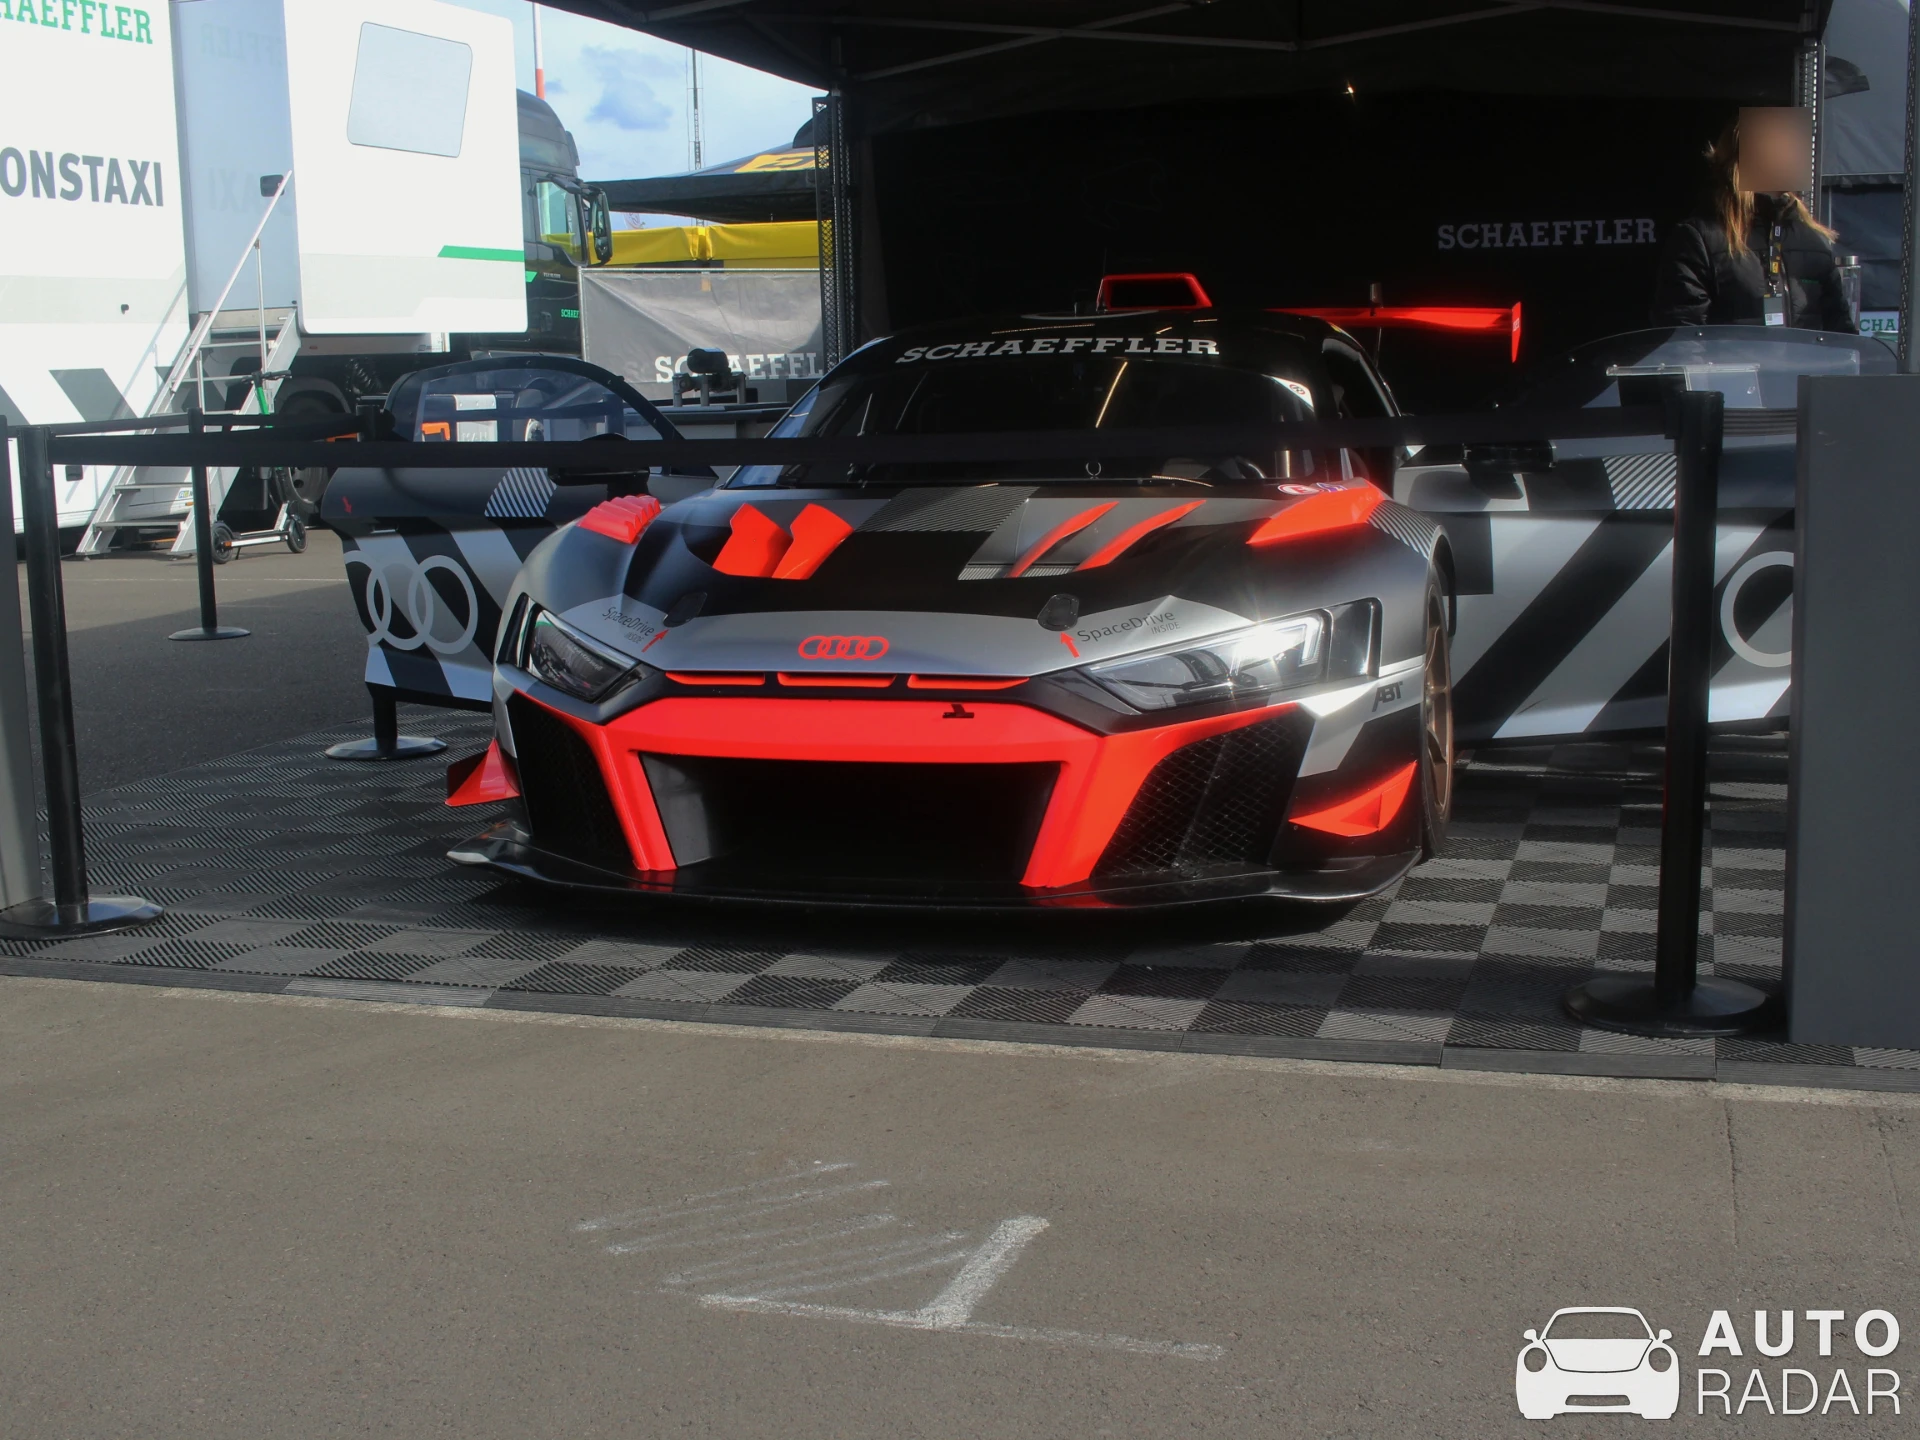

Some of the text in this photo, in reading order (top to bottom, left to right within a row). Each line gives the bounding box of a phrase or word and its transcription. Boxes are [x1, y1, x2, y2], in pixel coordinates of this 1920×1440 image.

[0, 147, 164, 207] ONSTAXI
[1437, 219, 1657, 250] SCHAEFFLER
[895, 337, 1220, 363] SCHAEFFLER
[602, 606, 655, 637] SpaceDrive
[1077, 612, 1176, 642] SpaceDrive
[1151, 621, 1180, 635] INSIDE
[1371, 681, 1403, 712] ABT
